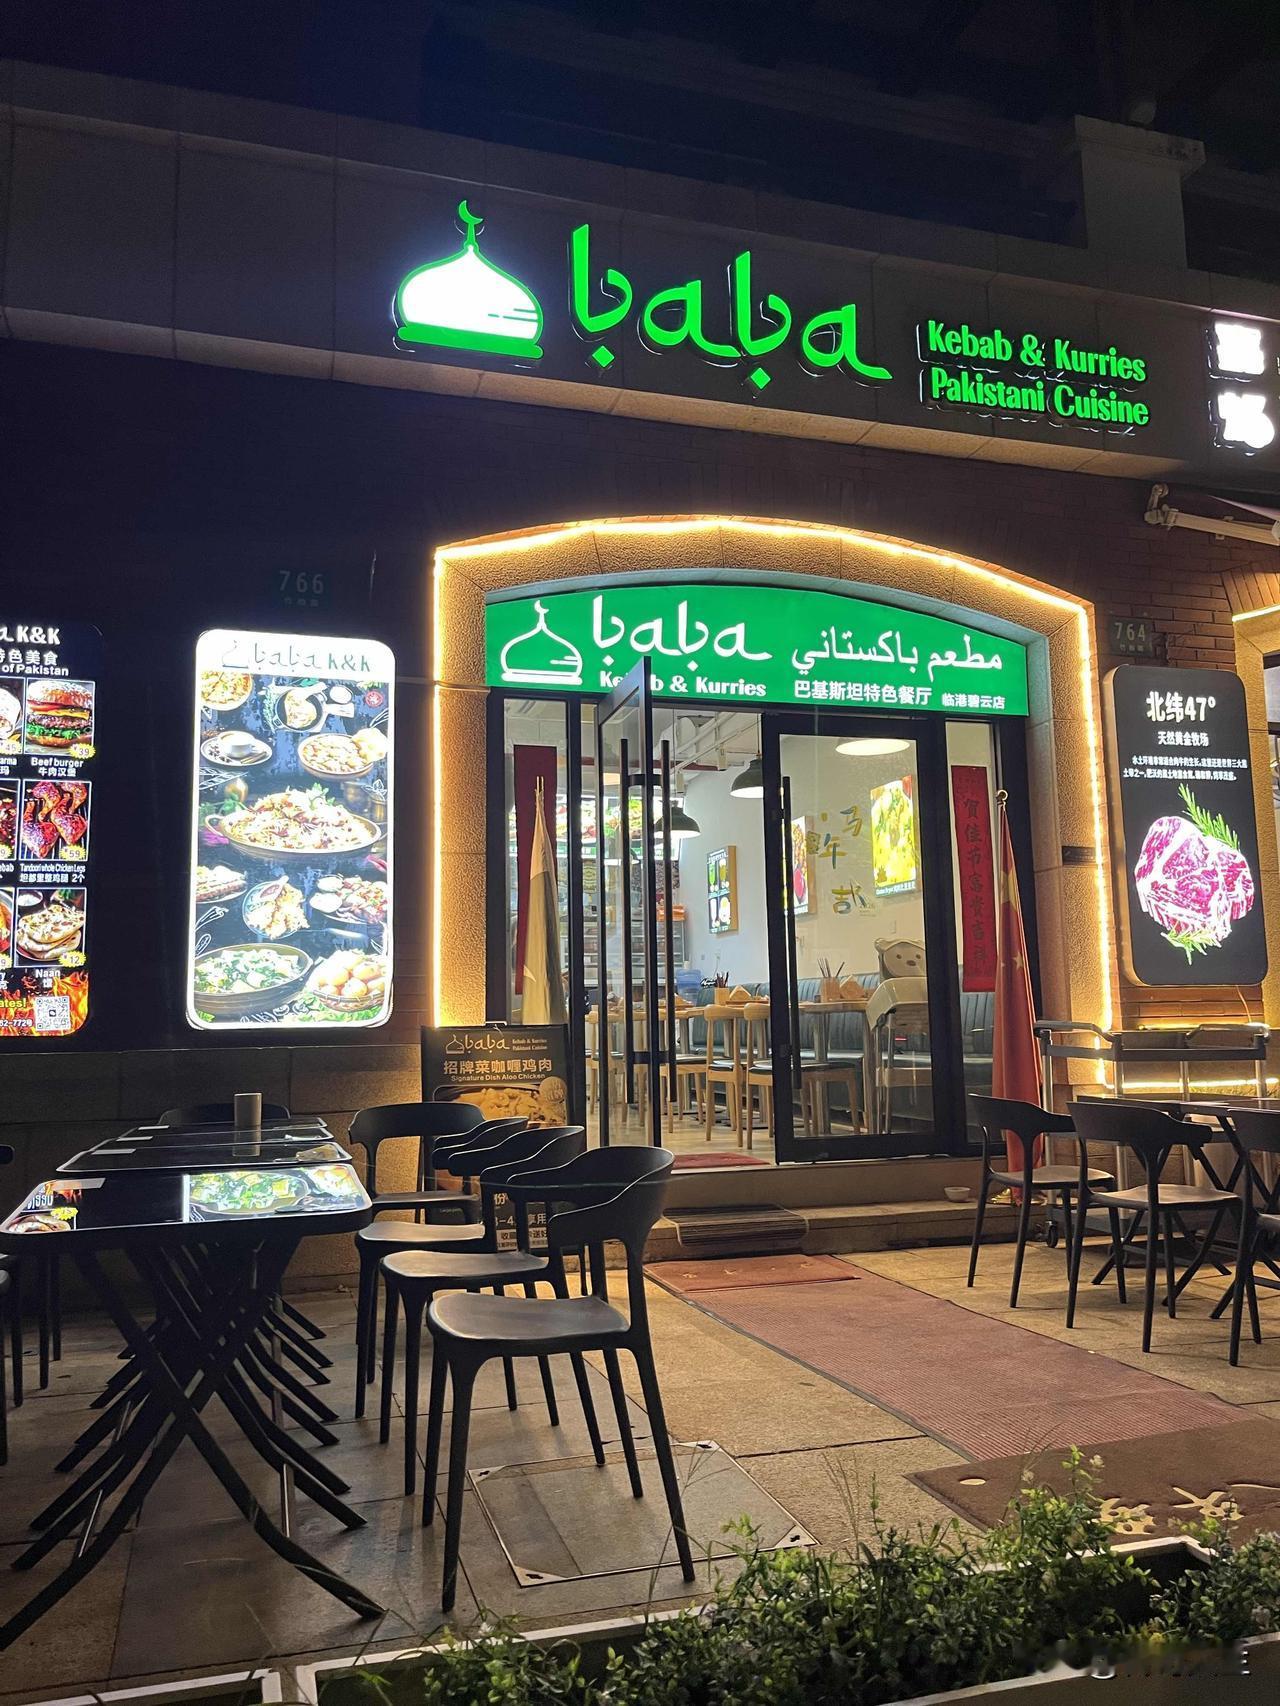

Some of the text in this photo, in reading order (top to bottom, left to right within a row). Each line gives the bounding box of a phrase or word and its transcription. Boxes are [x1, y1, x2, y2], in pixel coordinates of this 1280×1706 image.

[573, 223, 893, 390] baba
[928, 320, 1147, 382] Kebab & Kurries
[931, 367, 1149, 426] Pakistani Cuisine
[279, 570, 324, 594] 766
[17, 625, 61, 645] K&K
[593, 594, 773, 671] baba
[1114, 622, 1146, 642] 764
[791, 626, 1003, 683] مطعم باكستاني
[2, 664, 70, 677] of Pakistan
[669, 675, 689, 693] &
[695, 676, 767, 697] Kurries
[794, 680, 1006, 709] 巴基斯坦特色餐厅 临港碧云店
[31, 757, 84, 768] Beef burger
[38, 767, 77, 777] 牛肉汉堡
[55, 863, 74, 872] Chicken
[36, 969, 60, 978] Naan
[465, 1034, 510, 1053] baba
[443, 1058, 552, 1075] 招牌菜咖喱鸡肉
[451, 1071, 546, 1083] Signature Dish Aloo Chicken
